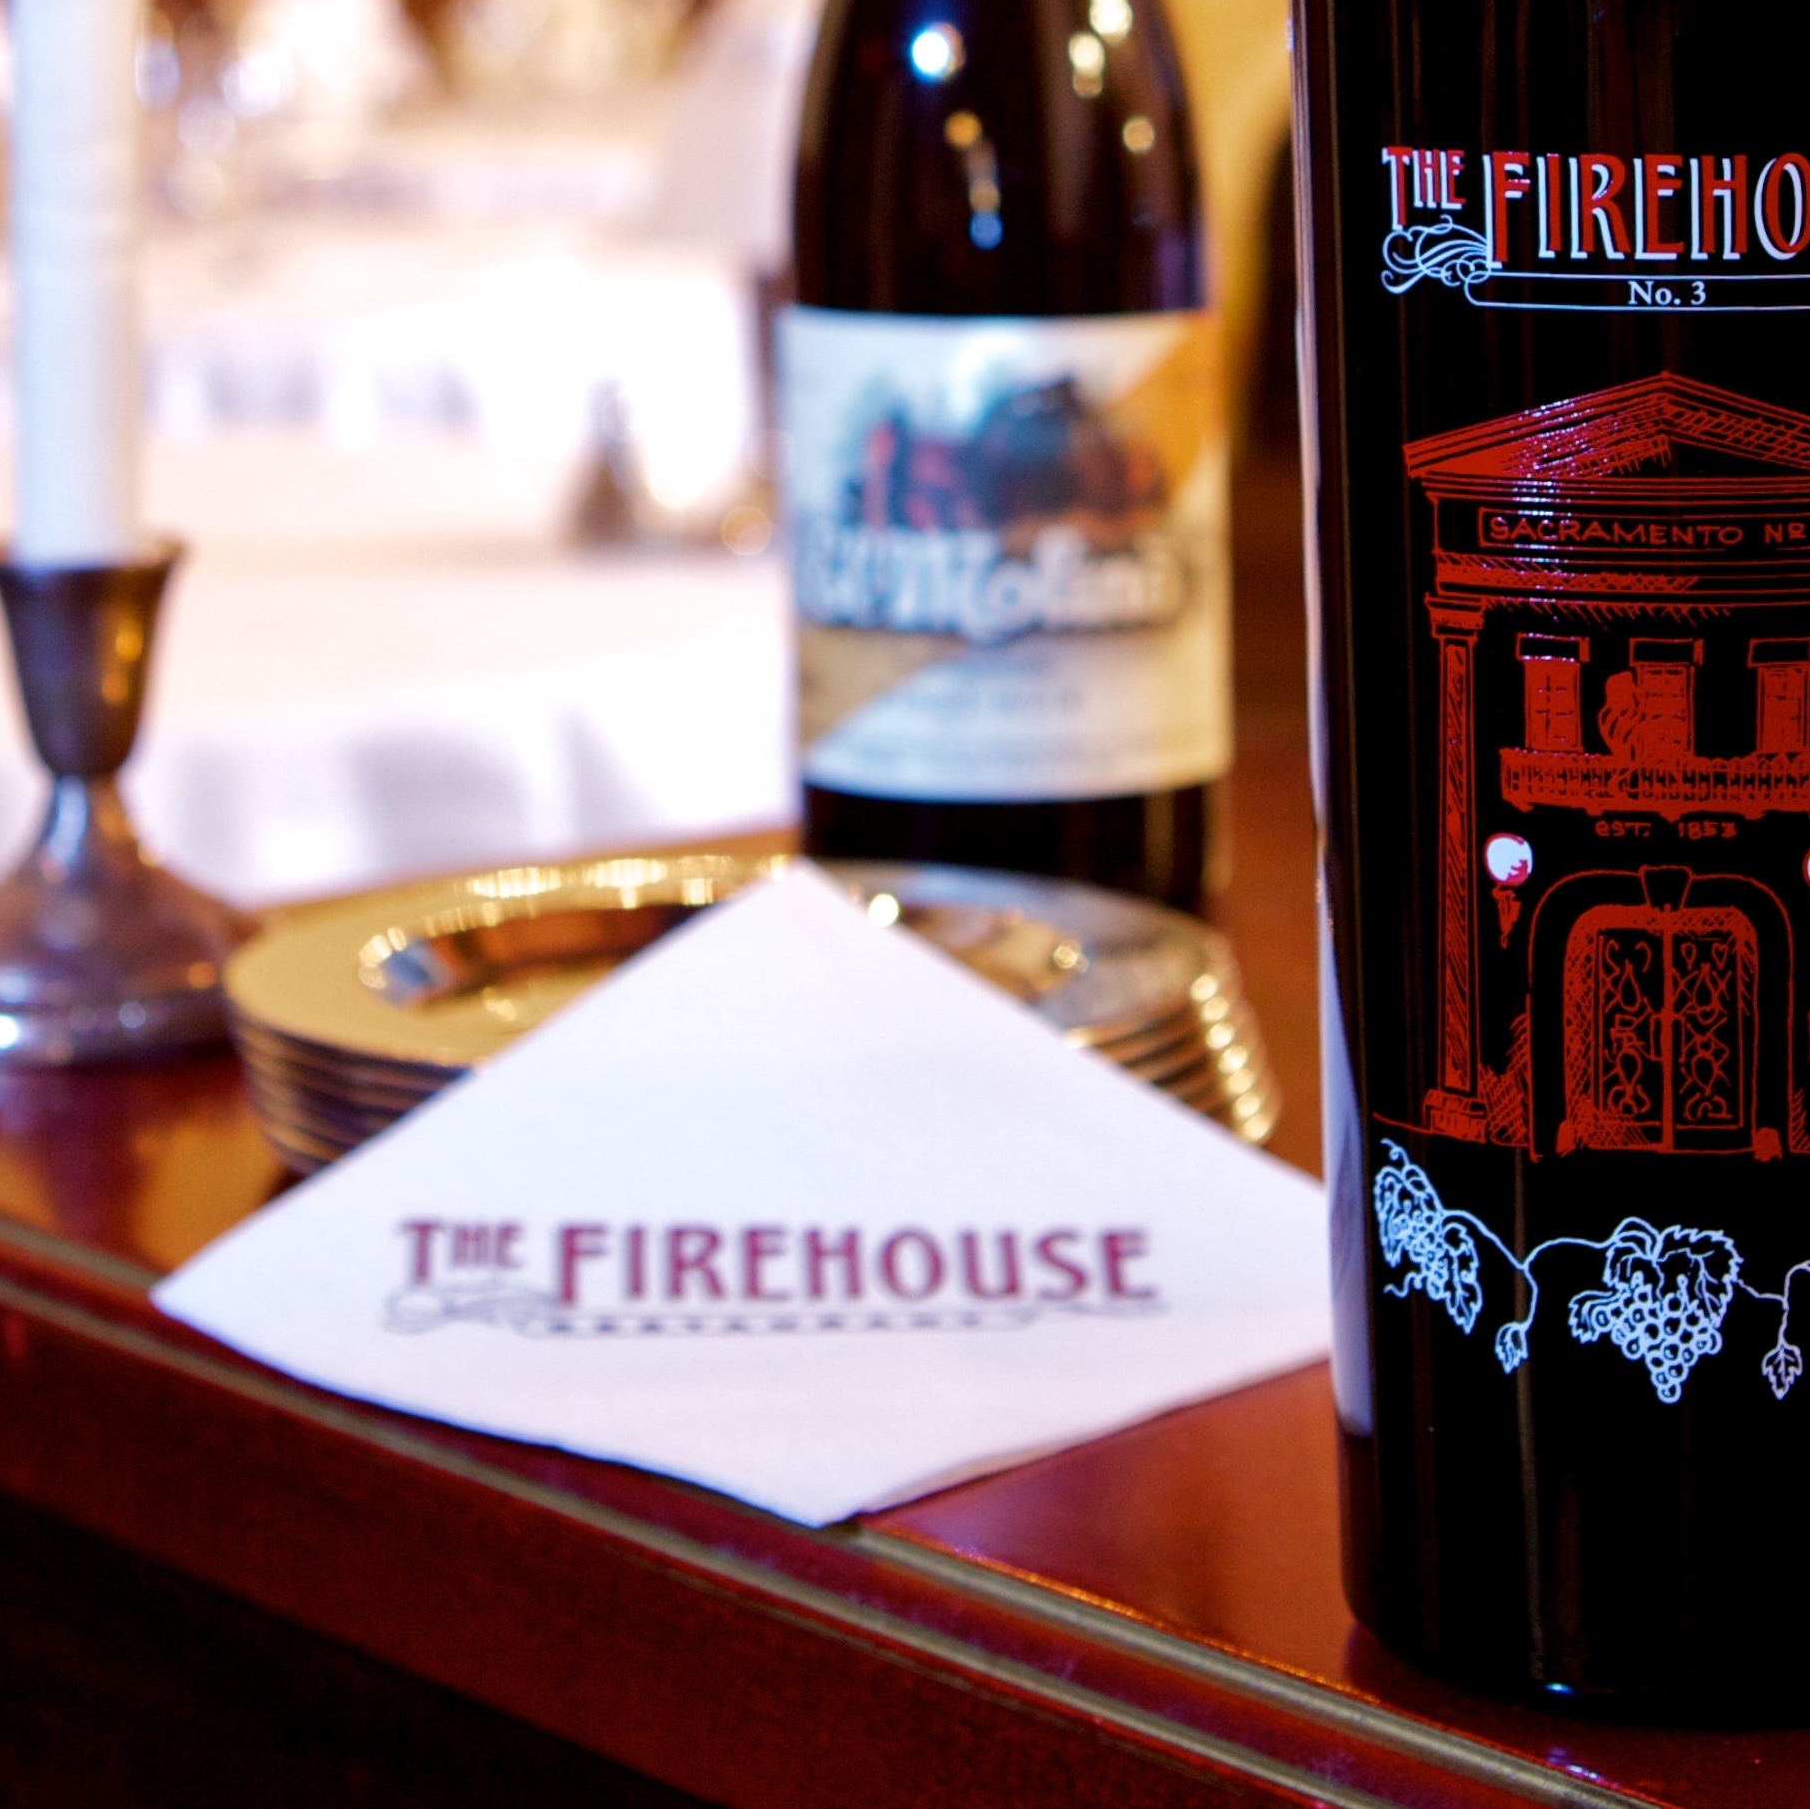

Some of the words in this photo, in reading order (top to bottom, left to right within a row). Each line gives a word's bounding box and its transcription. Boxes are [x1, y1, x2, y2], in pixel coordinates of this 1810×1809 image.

[1382, 147, 1466, 231] THE
[1627, 280, 1681, 306] No.
[1690, 280, 1707, 306] 3
[1490, 516, 1743, 546] SACRAMENTO
[1677, 820, 1737, 840] 1853
[398, 1218, 525, 1288] THE
[555, 1222, 1161, 1308] FIREHOUSE
